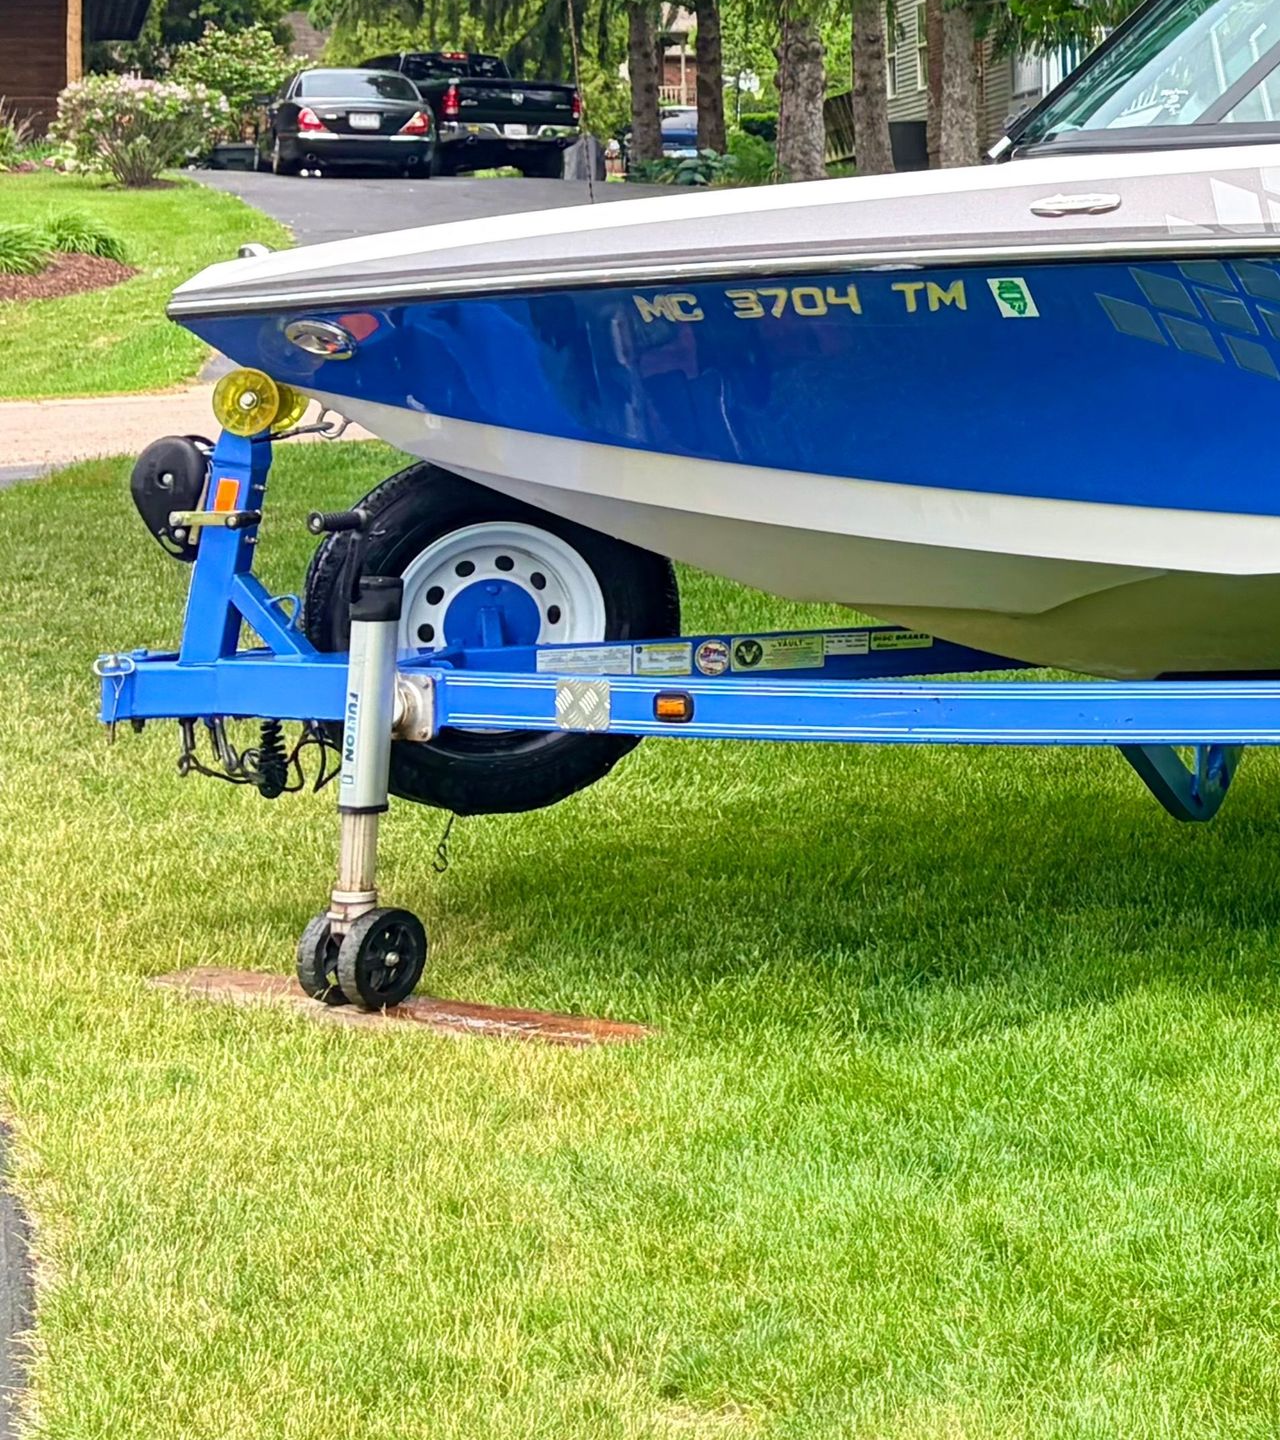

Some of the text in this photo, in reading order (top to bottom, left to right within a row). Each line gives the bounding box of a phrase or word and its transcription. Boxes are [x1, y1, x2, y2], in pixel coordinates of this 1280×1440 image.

[633, 279, 968, 323] MC 3704 TM
[345, 692, 359, 762] FULTON
